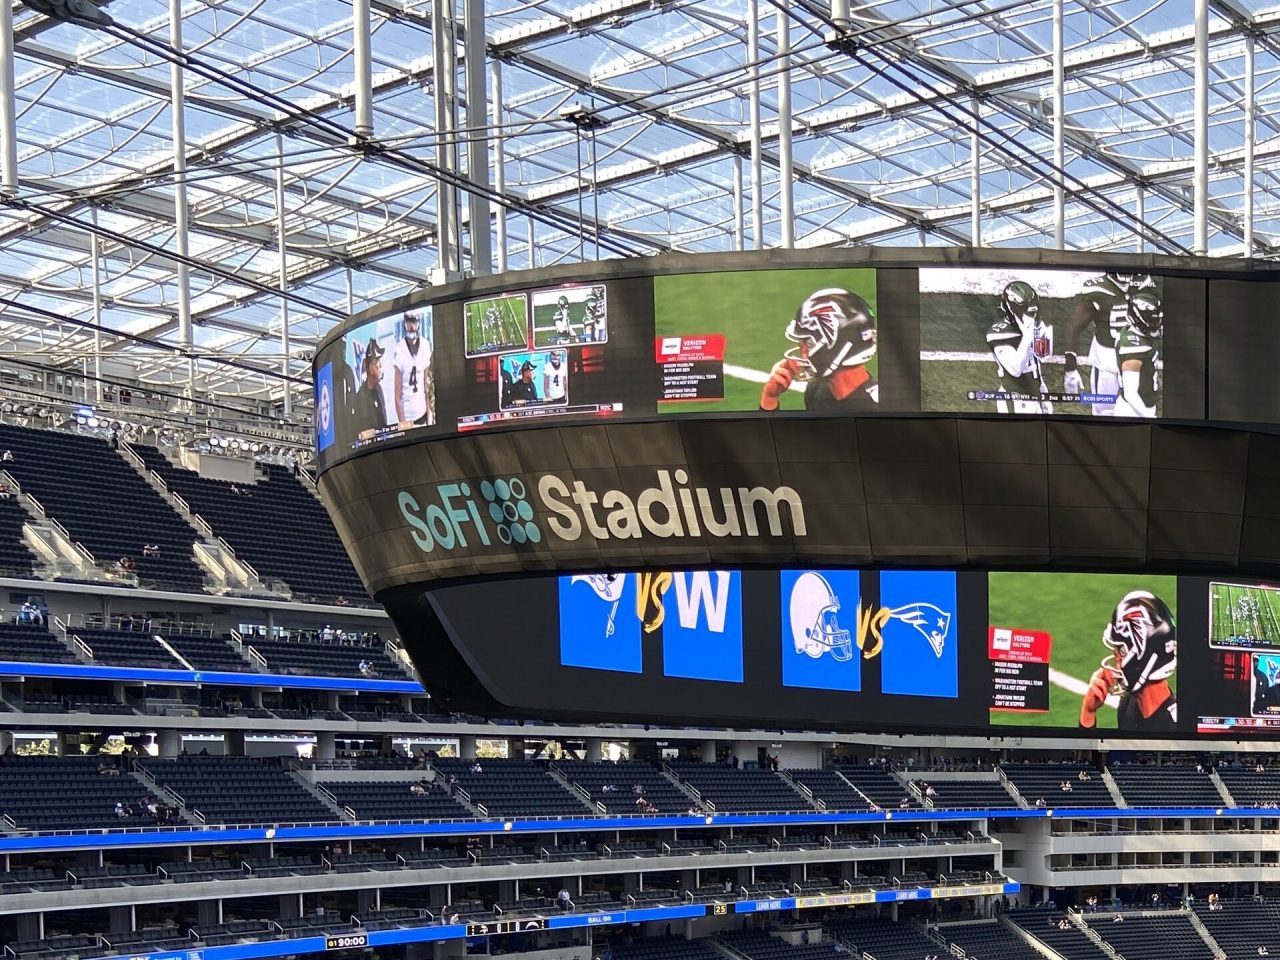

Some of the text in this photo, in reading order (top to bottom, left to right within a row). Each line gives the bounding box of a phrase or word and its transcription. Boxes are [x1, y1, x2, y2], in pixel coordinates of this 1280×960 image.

[409, 365, 418, 393] 4
[398, 469, 807, 553] SoFi Stadium
[636, 571, 731, 633] VS W
[856, 594, 890, 659] VS
[715, 904, 726, 914] 25
[328, 936, 365, 948] Q1 90:00
